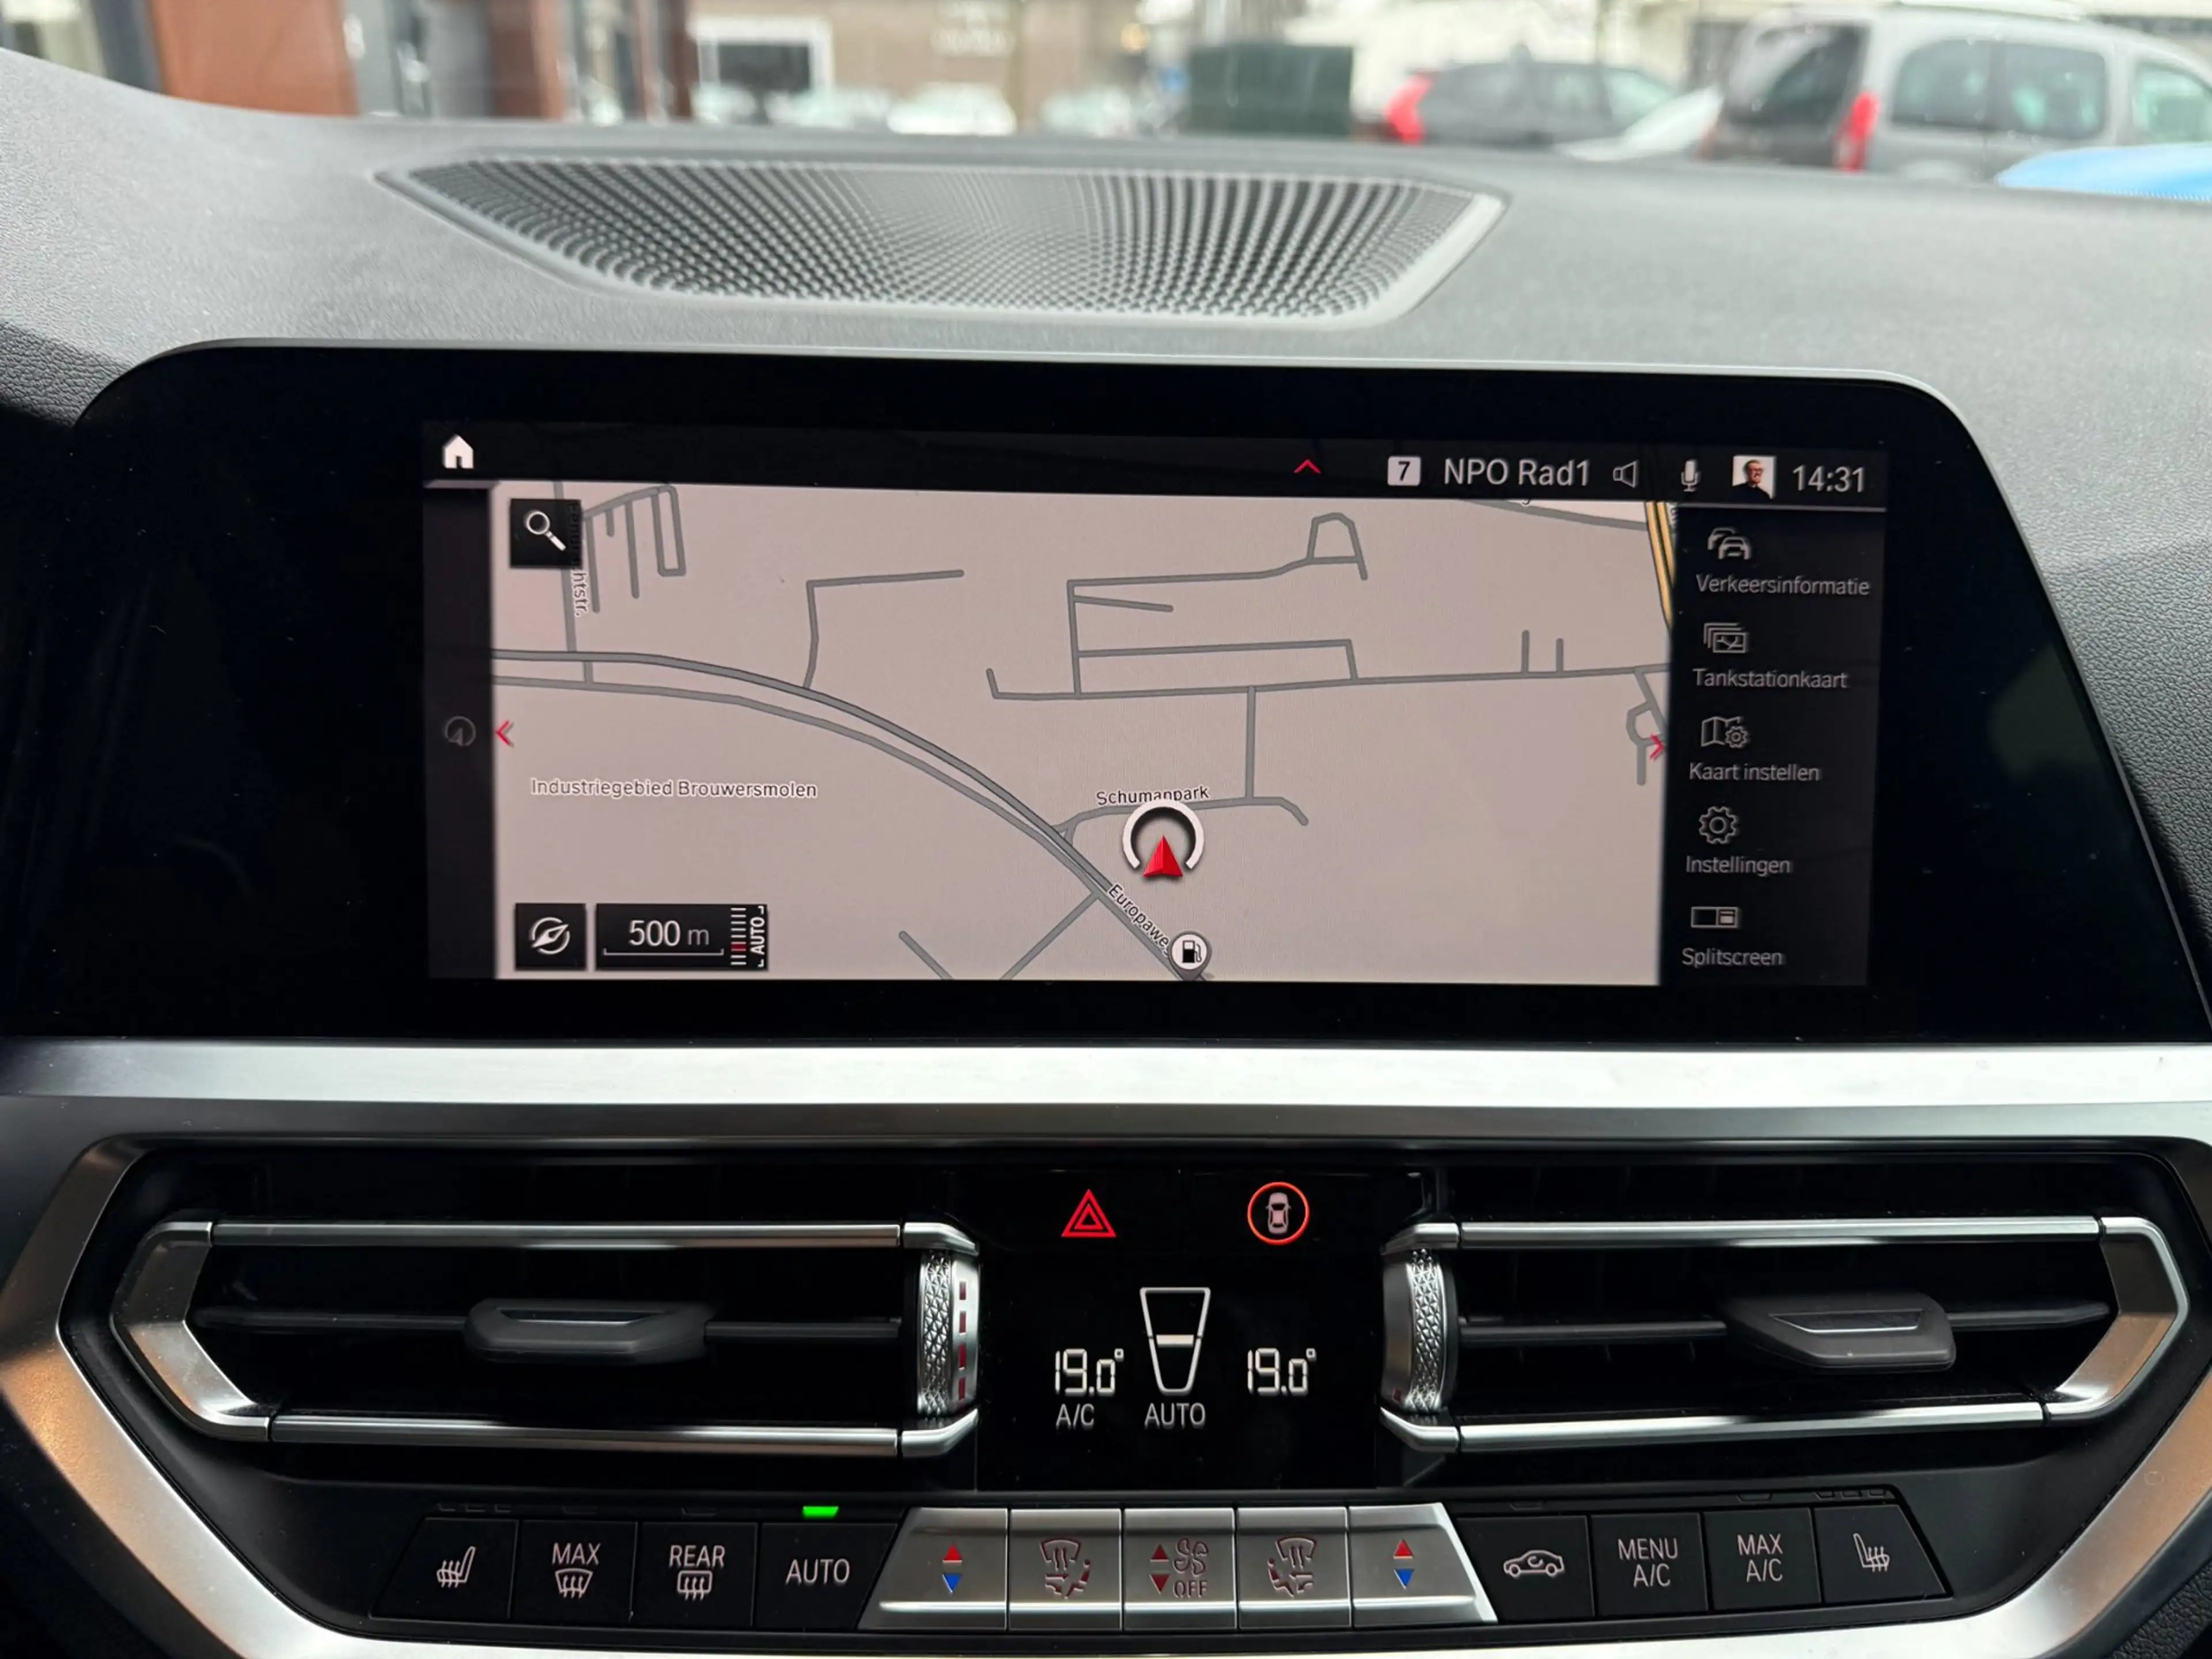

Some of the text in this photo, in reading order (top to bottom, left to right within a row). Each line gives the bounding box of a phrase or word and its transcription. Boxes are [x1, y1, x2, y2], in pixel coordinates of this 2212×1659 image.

[1398, 461, 1411, 482] 7
[1444, 458, 1589, 486] NPO Rad1
[1792, 465, 1865, 493] 14:31
[1696, 574, 1870, 596] Verkeersinformatie
[1692, 668, 1849, 689] Tankstationkaart
[1690, 762, 1821, 782] Kaart instellen
[532, 779, 817, 798] Industriegebied Brouwersmolen
[1686, 855, 1793, 877] Instellingen
[629, 920, 710, 946] 500 m
[749, 916, 766, 955] AUTO
[1681, 947, 1784, 969] Splitscreen
[1056, 1403, 1095, 1427] A/C
[1144, 1402, 1206, 1427] AUTO
[552, 1543, 601, 1565] MAX
[1618, 1538, 1679, 1560] MENU
[1737, 1533, 1783, 1555] MAX
[669, 1545, 725, 1567] REAR
[785, 1558, 851, 1585] AUTO
[1633, 1563, 1671, 1588] A/C
[1746, 1558, 1783, 1582] A/C
[1173, 1579, 1208, 1598] OFF
